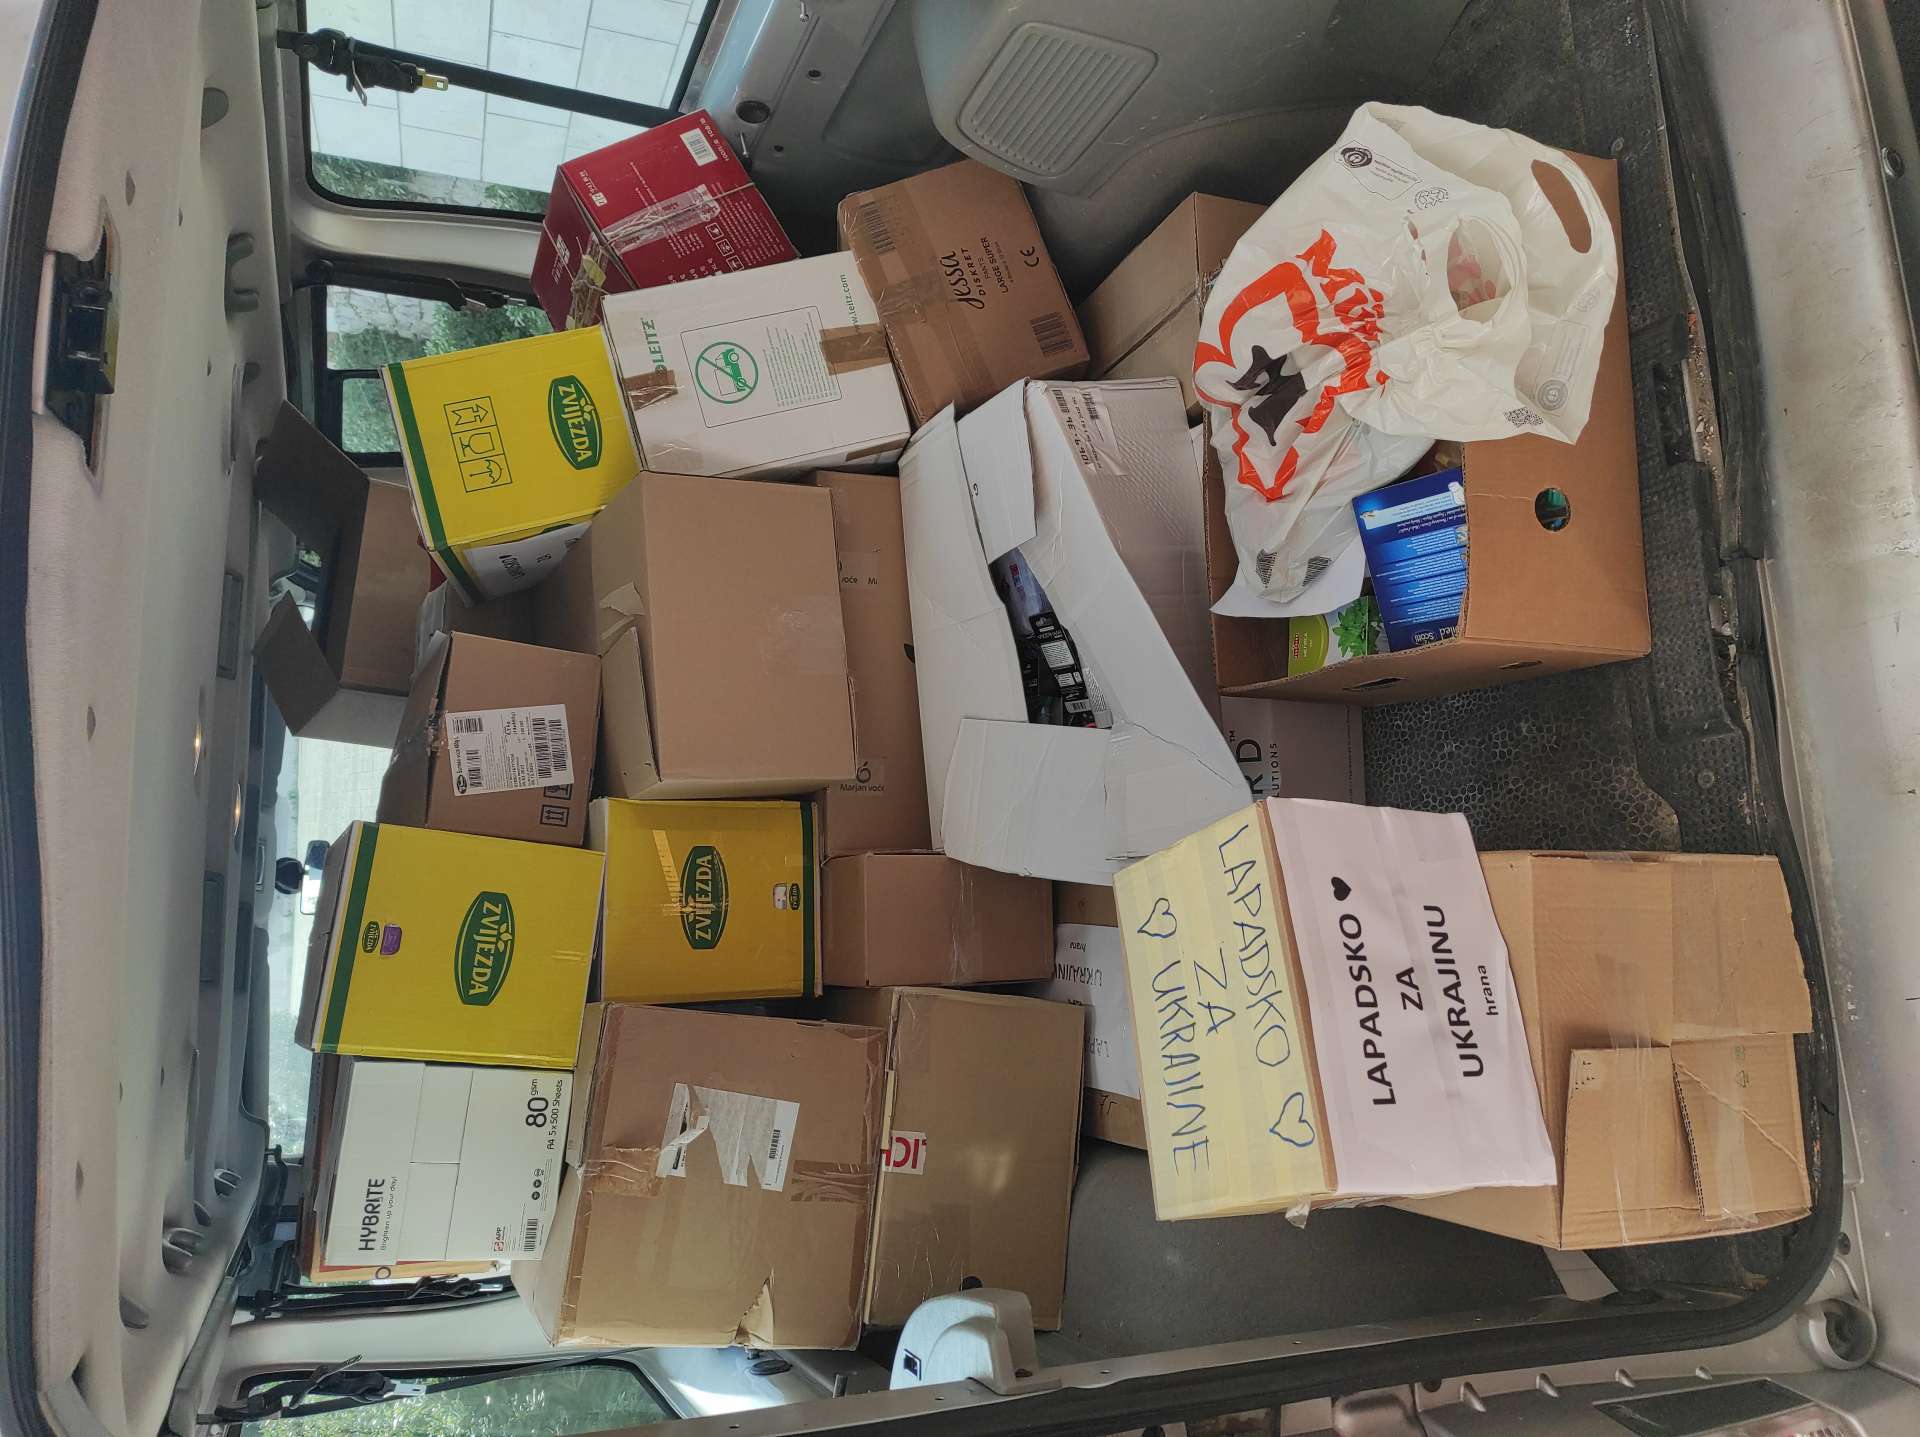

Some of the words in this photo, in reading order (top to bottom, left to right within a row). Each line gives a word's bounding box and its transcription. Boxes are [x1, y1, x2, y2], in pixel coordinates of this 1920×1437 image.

[960, 247, 986, 296] DISKRET
[980, 236, 998, 264] SUPER
[992, 264, 1010, 293] LARGE
[641, 319, 666, 363] LEITZ
[558, 383, 593, 462] ZVIJEZDA
[1270, 743, 1280, 798] LUTIONS
[693, 854, 716, 940] ZVIJEZDA
[468, 900, 502, 995] ZVIJEZDA
[1218, 824, 1290, 1067] LAPADSKO
[1192, 947, 1236, 1034] ZA
[1338, 914, 1397, 1106] LAPADSKO
[1395, 966, 1424, 1012] ZA
[1424, 904, 1484, 1078] UKRAJINU
[1476, 964, 1498, 1016] hrana
[530, 1078, 539, 1096] gsm
[550, 1080, 563, 1107] Sheets
[1152, 960, 1210, 1174] UKRAJINE
[525, 1097, 549, 1128] 80
[546, 1139, 556, 1150] A4
[358, 1178, 386, 1251] HYBRITE
